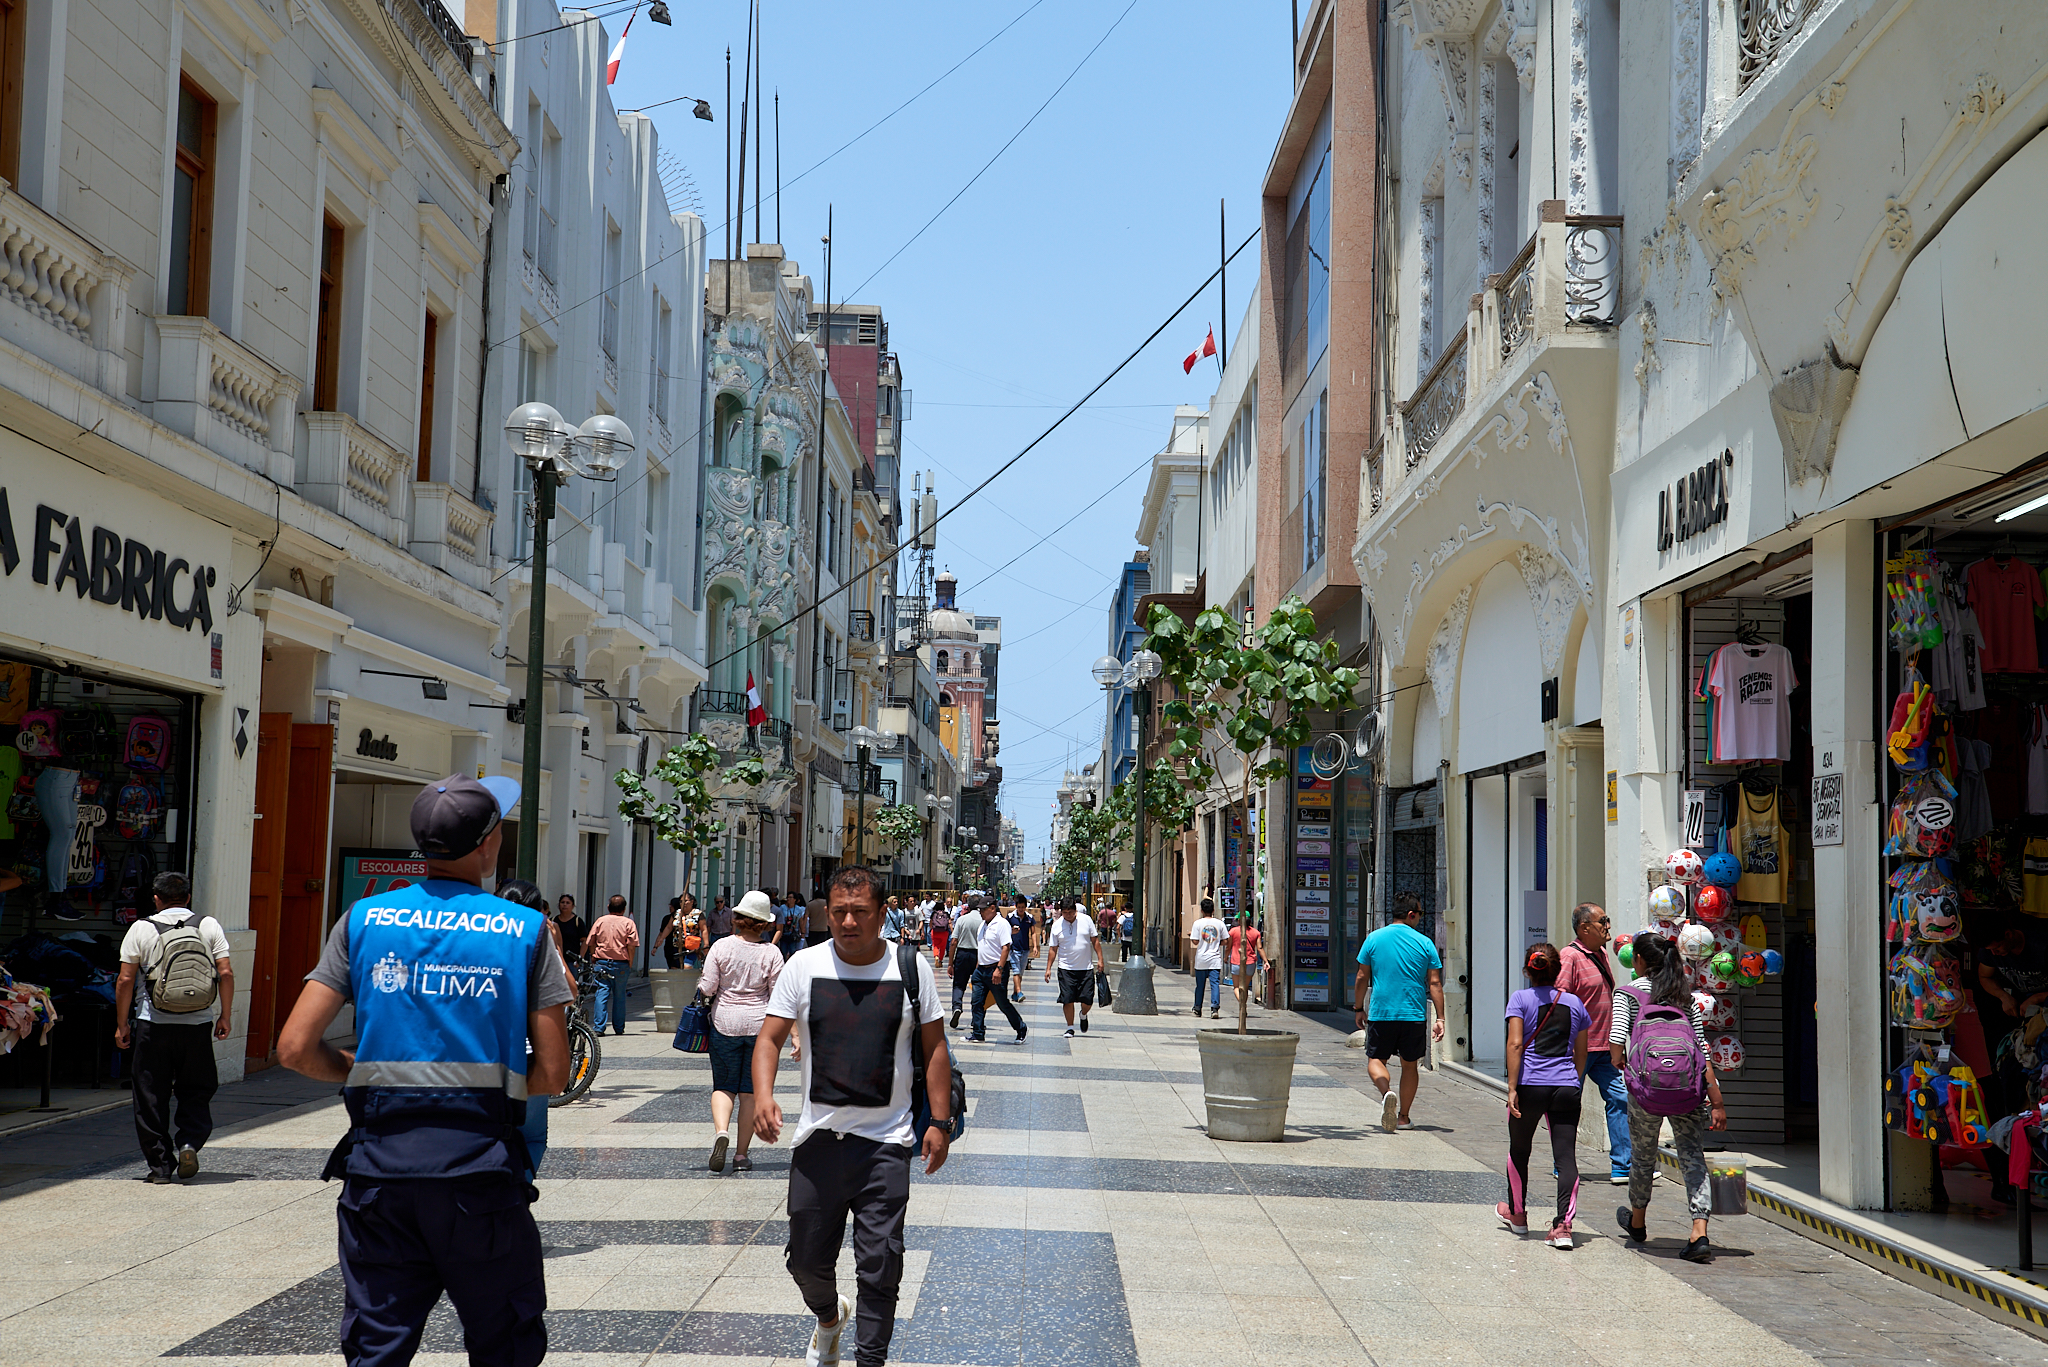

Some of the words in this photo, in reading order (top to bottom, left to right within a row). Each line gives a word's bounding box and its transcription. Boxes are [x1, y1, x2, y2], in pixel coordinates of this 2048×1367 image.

[1658, 483, 1674, 551] LA
[1676, 451, 1728, 542] FABRICA
[32, 504, 213, 637] FABRICA
[1738, 672, 1772, 689] TENEMOS
[1740, 680, 1772, 704] RAZON
[356, 728, 398, 760] Bata
[1822, 752, 1832, 768] 434
[361, 862, 425, 874] ESCOLARES
[364, 907, 524, 938] FISCALIZACIÓN
[424, 963, 489, 974] MUNICIPALIDAD
[491, 968, 503, 976] DE
[421, 974, 498, 998] LIMA
